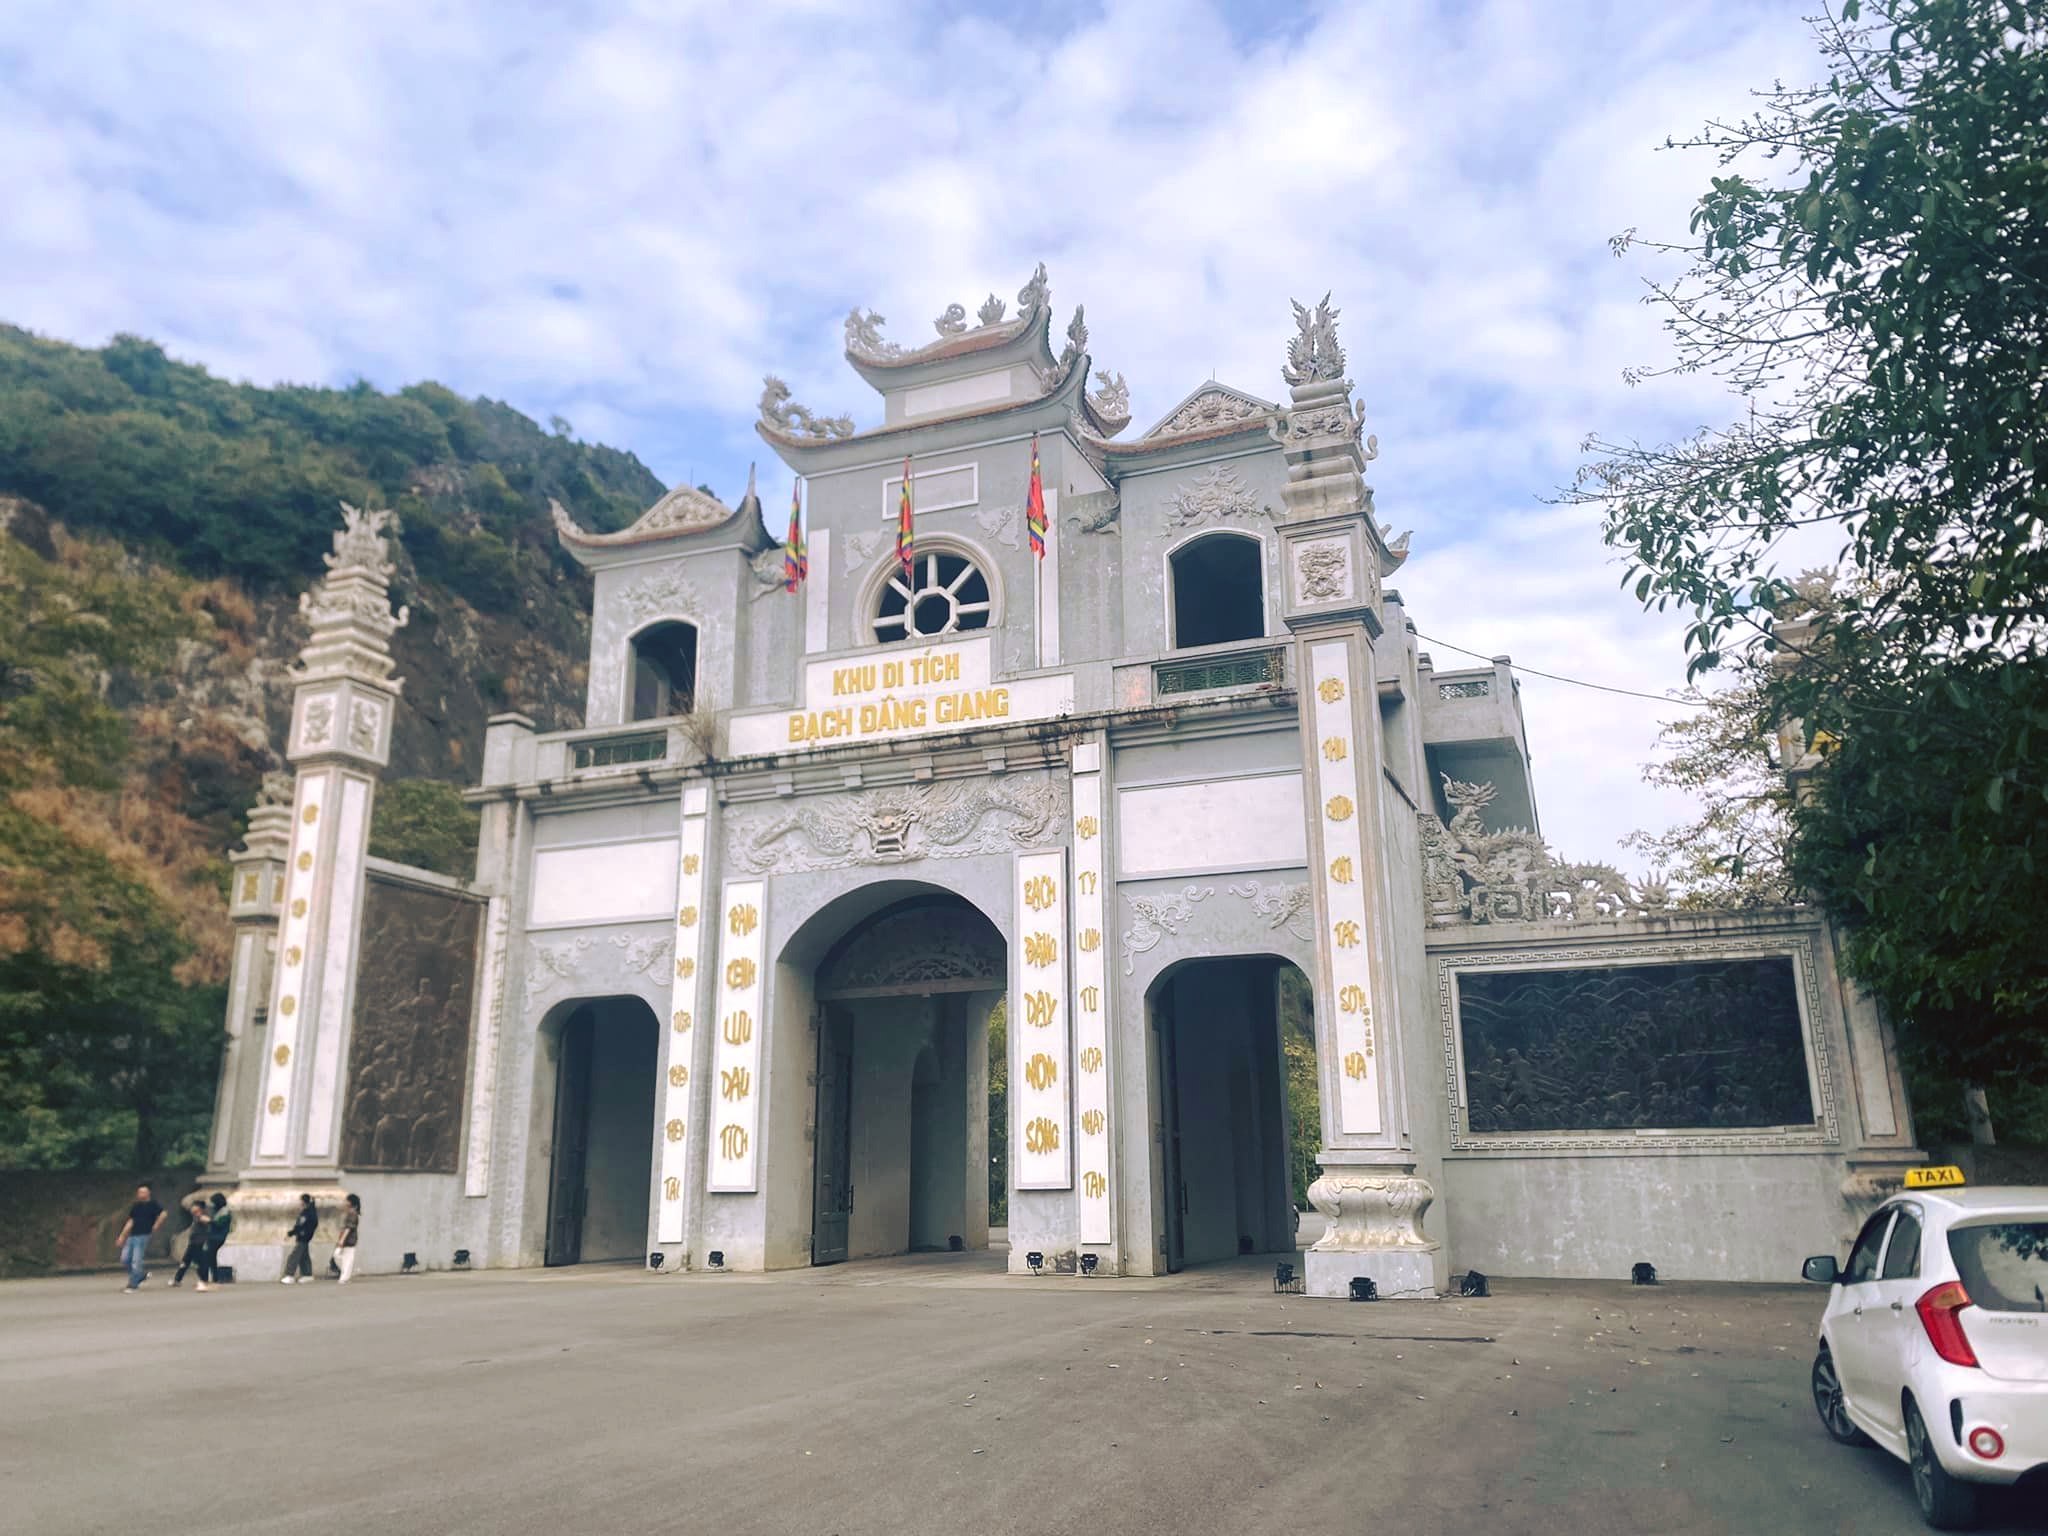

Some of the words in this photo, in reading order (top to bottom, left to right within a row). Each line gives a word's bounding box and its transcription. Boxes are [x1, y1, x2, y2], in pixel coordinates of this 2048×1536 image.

[833, 664, 876, 696] KHU
[883, 661, 904, 689] DI
[910, 648, 960, 685] TÍCH
[789, 707, 853, 745] BẠCH
[936, 688, 1009, 723] GIANG
[1913, 1169, 1955, 1182] TAXI
